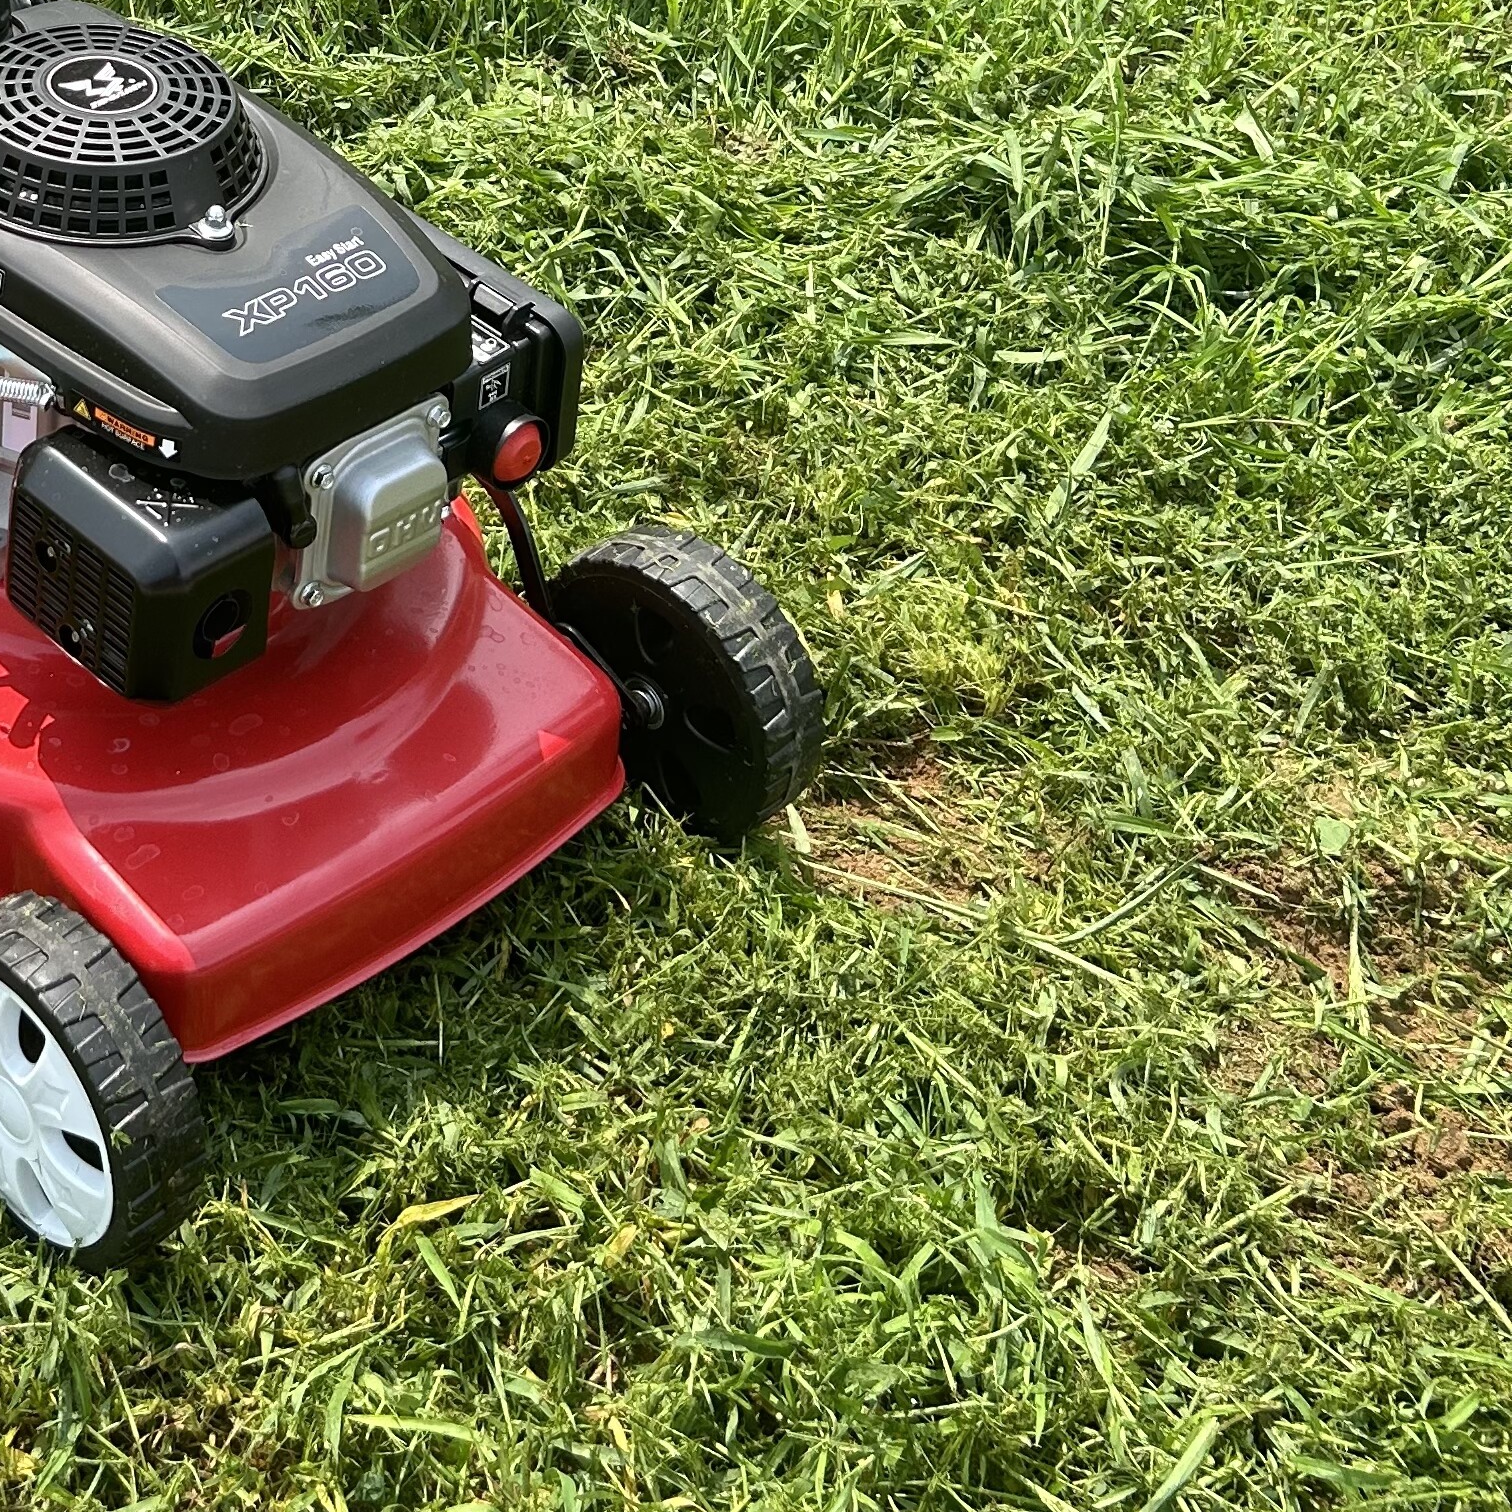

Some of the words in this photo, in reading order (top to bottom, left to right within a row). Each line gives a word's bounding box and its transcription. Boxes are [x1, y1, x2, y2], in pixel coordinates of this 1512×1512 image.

[305, 248, 338, 267] Easy
[332, 235, 365, 255] Start
[222, 249, 387, 337] XP160
[107, 415, 149, 442] WARNING
